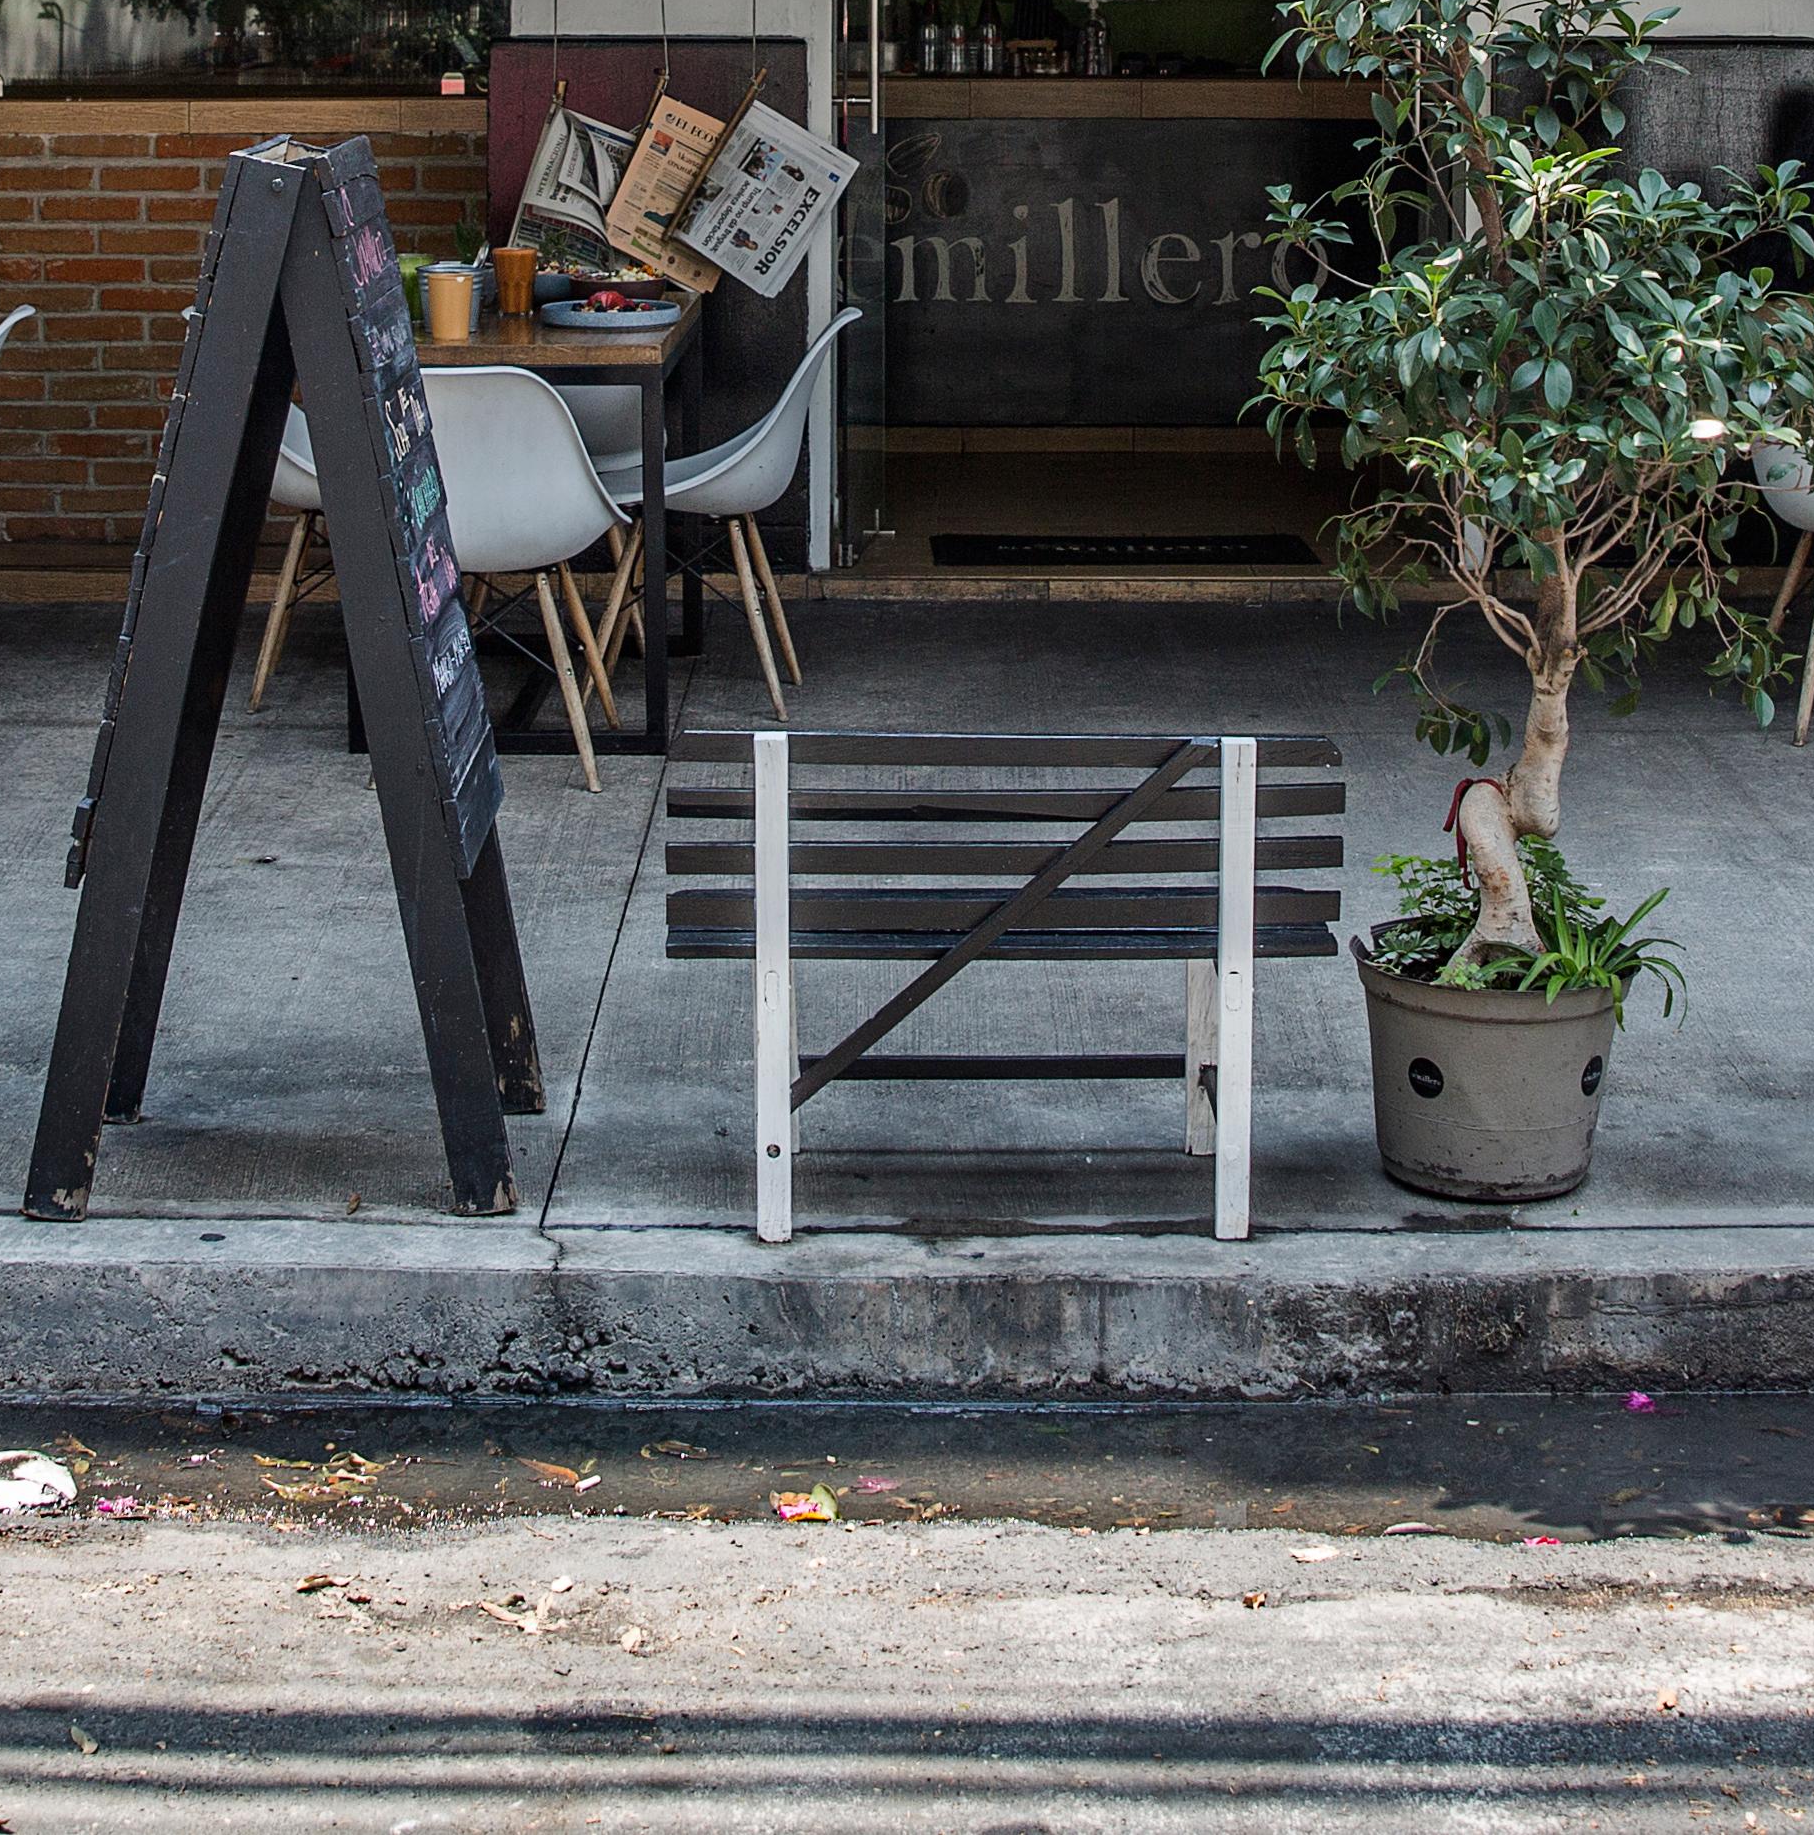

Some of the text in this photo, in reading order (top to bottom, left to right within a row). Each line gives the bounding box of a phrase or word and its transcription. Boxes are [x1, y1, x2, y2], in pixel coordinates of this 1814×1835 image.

[536, 133, 568, 197] INTERNACIONAL
[741, 186, 763, 209] Trump
[753, 185, 822, 276] EXCELSIOR
